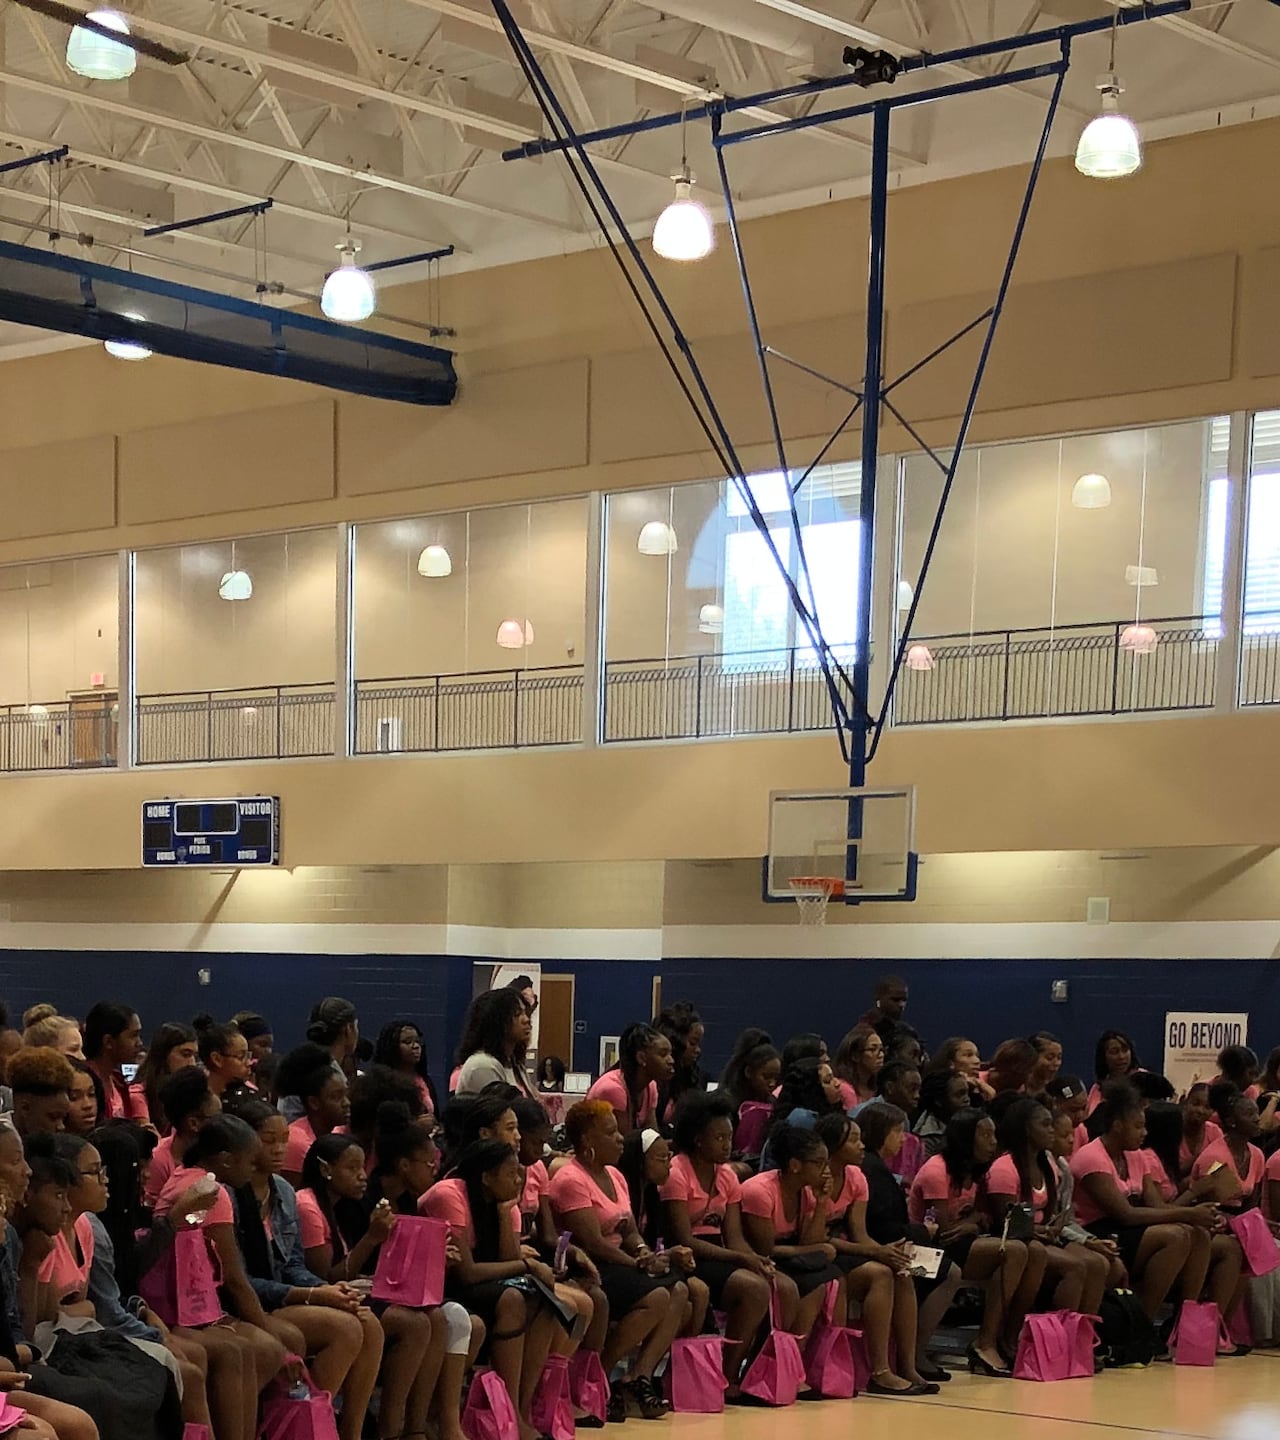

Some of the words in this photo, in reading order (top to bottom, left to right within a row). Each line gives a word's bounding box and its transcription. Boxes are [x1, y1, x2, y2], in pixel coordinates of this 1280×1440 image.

[147, 805, 171, 818] HOME
[239, 802, 272, 815] VISITOR
[1169, 1022, 1186, 1048] GO
[1191, 1022, 1241, 1049] BEYOND
